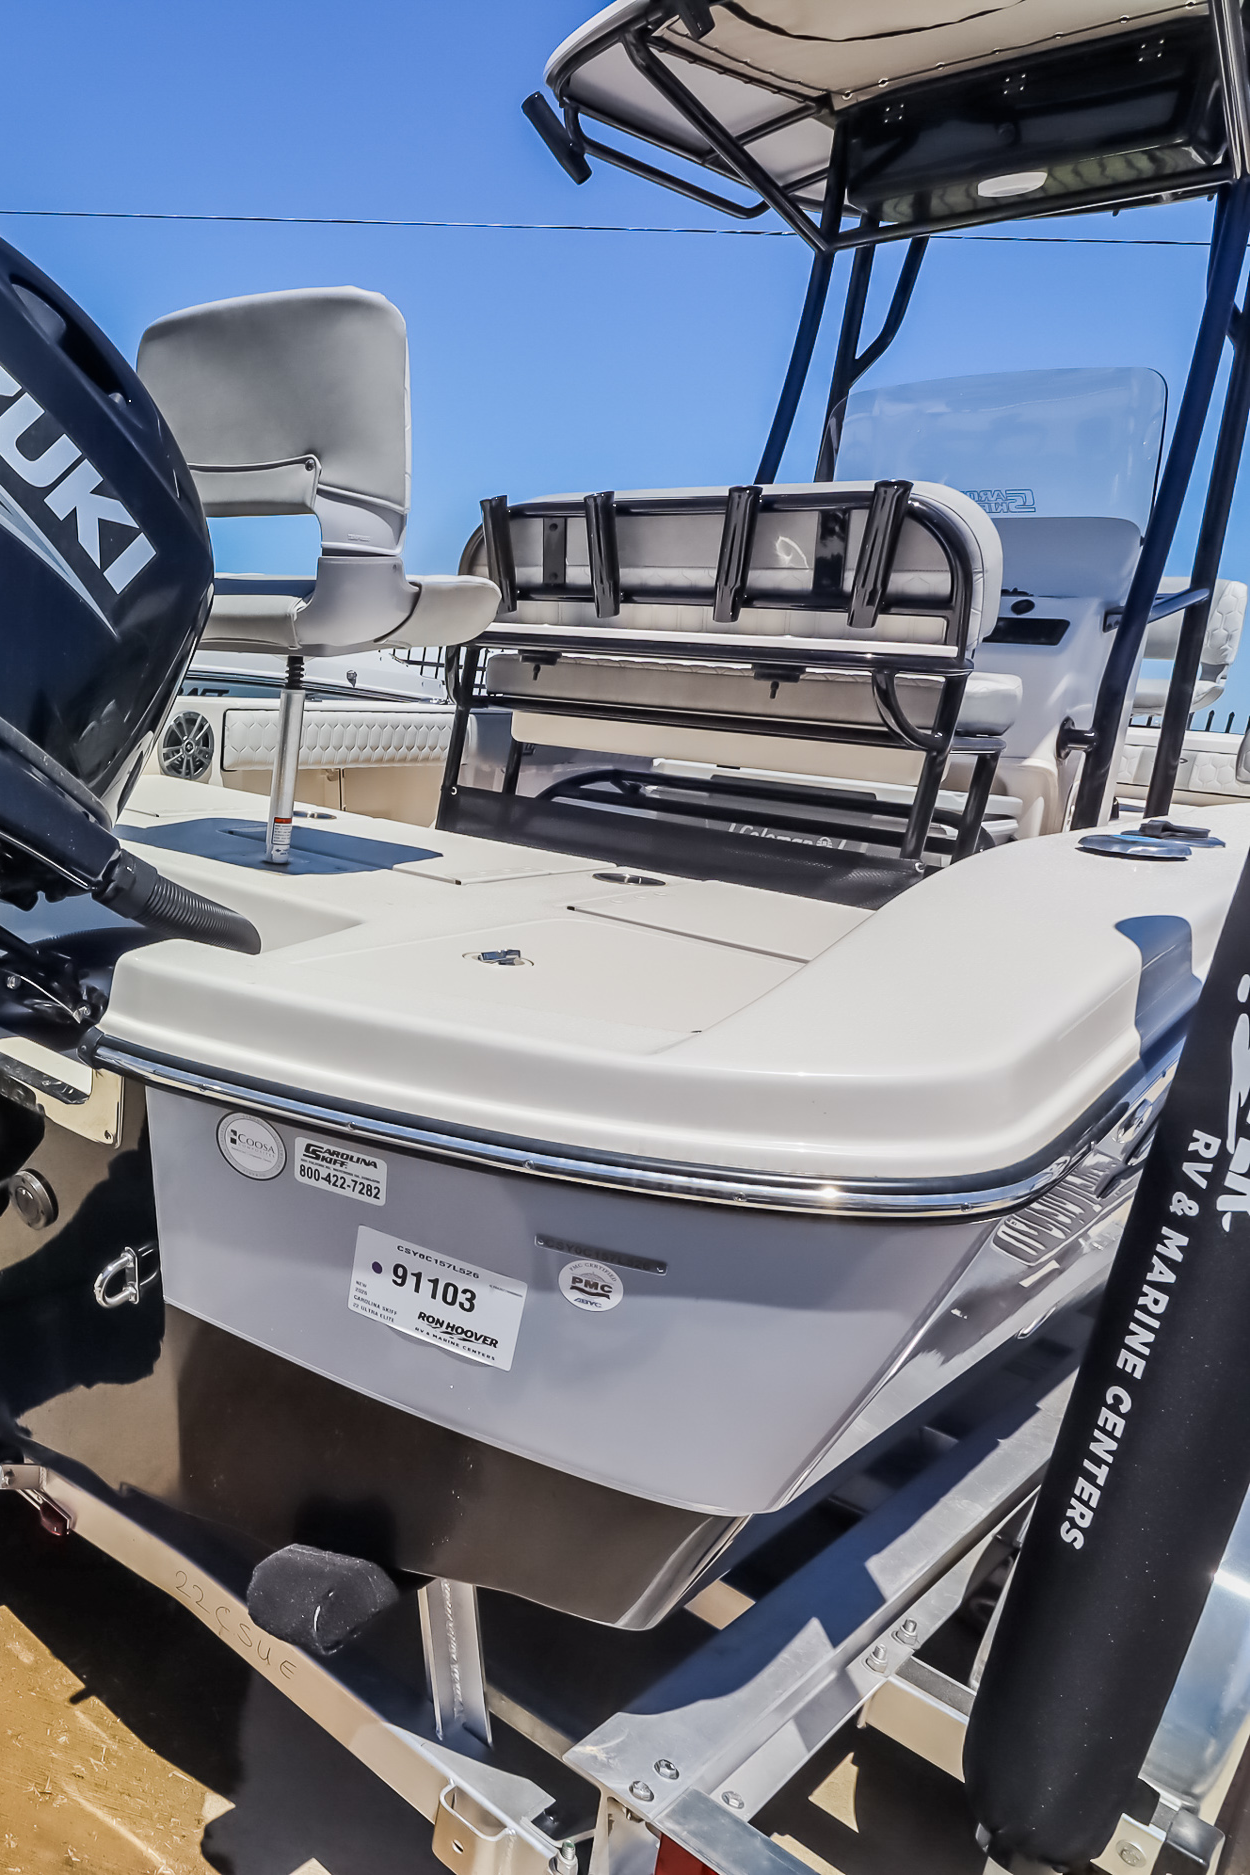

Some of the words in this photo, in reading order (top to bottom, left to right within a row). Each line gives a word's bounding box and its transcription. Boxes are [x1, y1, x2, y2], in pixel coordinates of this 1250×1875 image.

[238, 1133, 276, 1154] COOSA
[304, 1143, 378, 1169] CAROLINA
[1182, 1129, 1222, 1189] RV
[300, 1164, 381, 1200] 800-422-7282
[1169, 1191, 1199, 1217] &
[571, 1276, 613, 1293] PMC
[584, 1262, 617, 1282] CERTIFIED
[392, 1263, 477, 1313] 91103
[353, 1295, 380, 1309] CAROLINA
[382, 1306, 397, 1315] SKIFF
[361, 1306, 378, 1316] ULTRA
[1115, 1226, 1190, 1381] MARINE
[415, 1326, 424, 1334] RV
[433, 1334, 459, 1347] MARINE
[462, 1345, 495, 1361] CENTERS
[417, 1311, 445, 1329] RON
[445, 1322, 499, 1348] HOOVER
[1059, 1385, 1133, 1551] CENTERS
